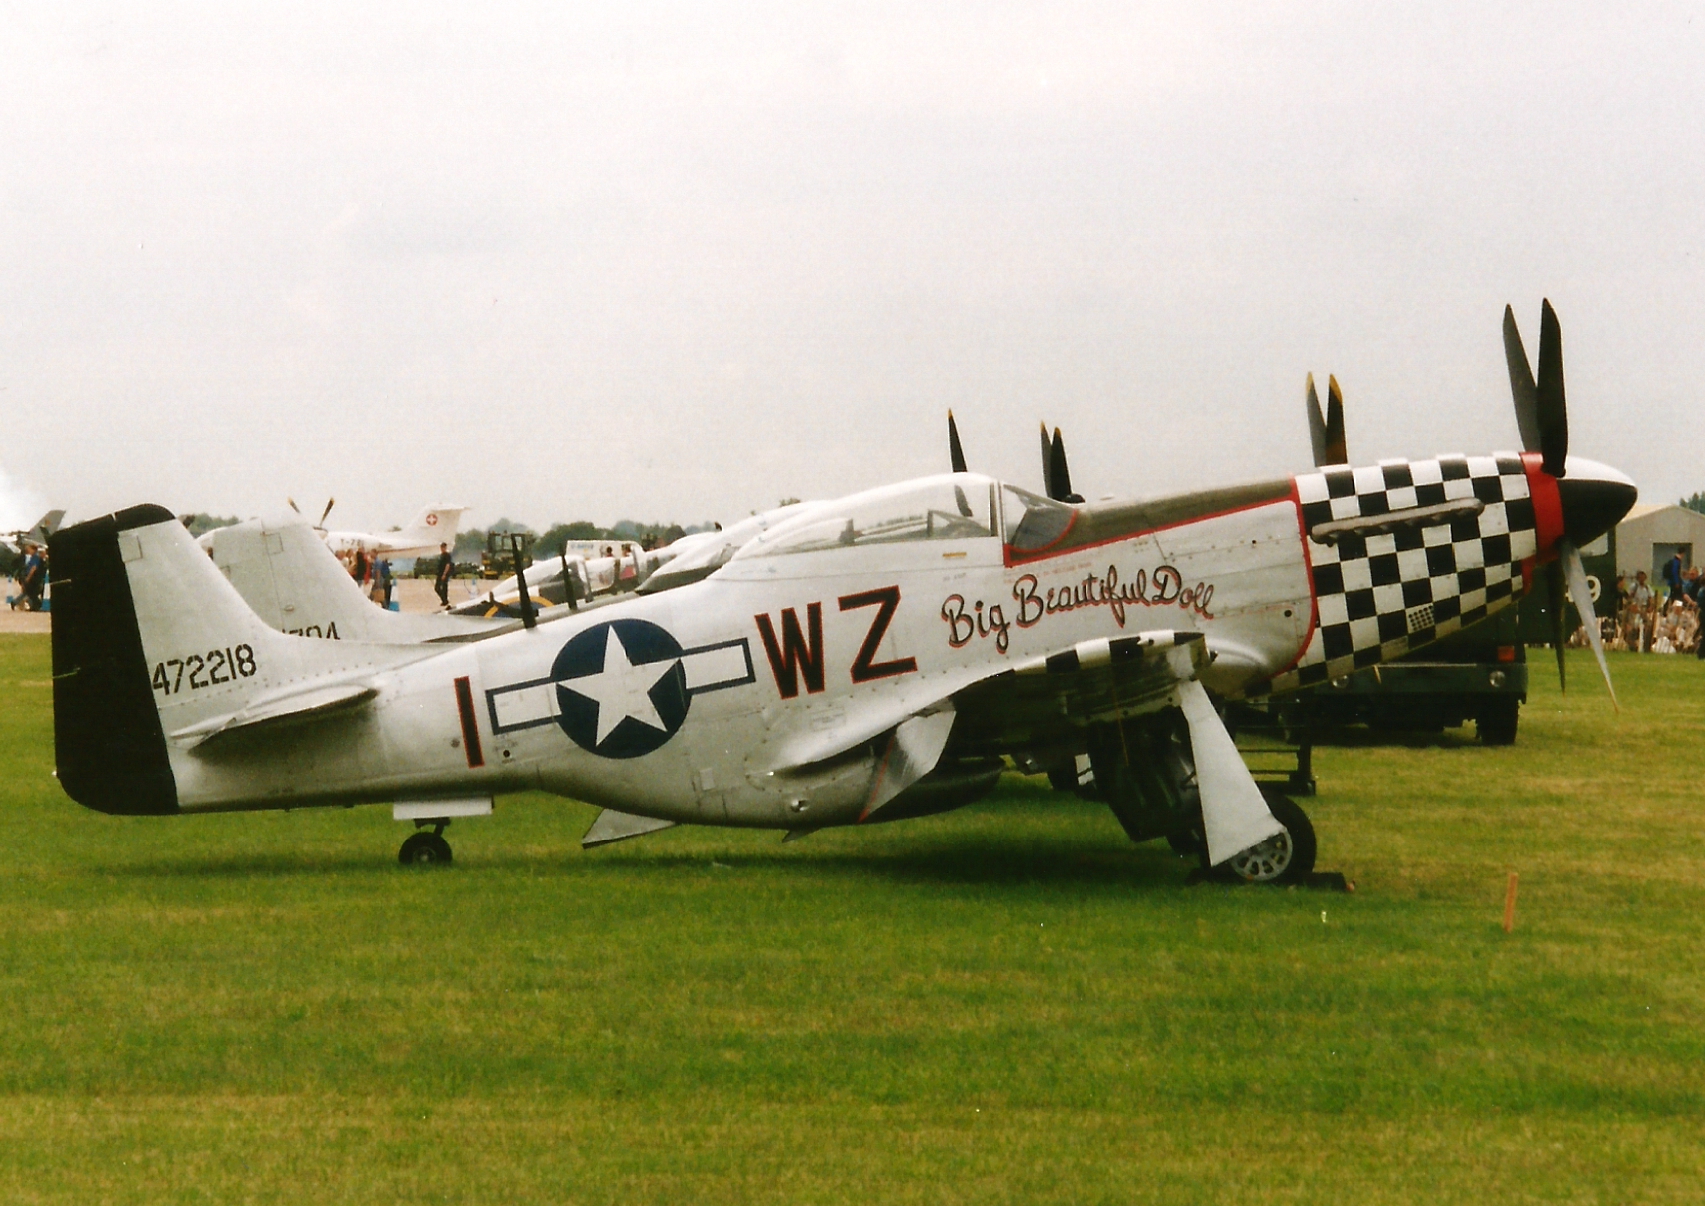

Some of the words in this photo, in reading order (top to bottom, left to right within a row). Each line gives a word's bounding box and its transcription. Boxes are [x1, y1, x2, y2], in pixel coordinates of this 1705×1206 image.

[754, 585, 918, 700] WZ
[941, 594, 1011, 654] Big
[1012, 564, 1151, 629] Beautiful
[1152, 565, 1215, 619] Doll
[152, 643, 257, 695] 472218
